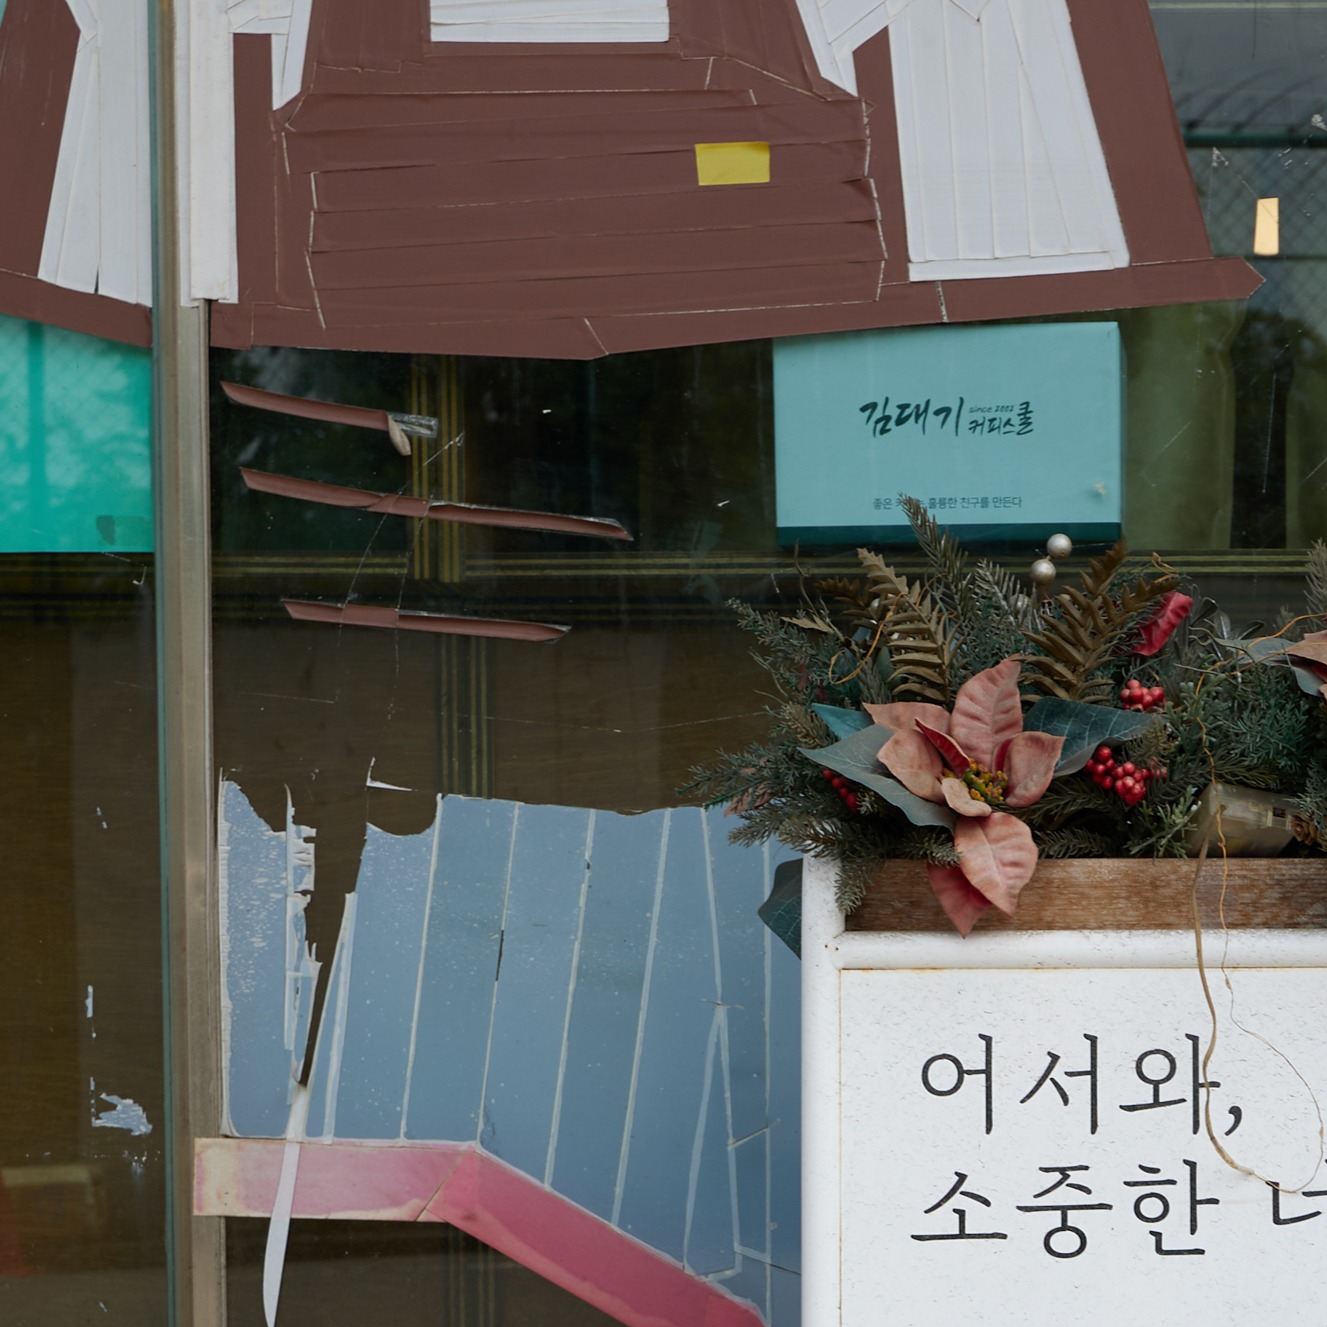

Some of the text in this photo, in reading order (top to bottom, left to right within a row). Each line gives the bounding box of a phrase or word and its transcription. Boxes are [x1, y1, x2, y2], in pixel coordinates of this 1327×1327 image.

[859, 396, 1034, 438] 김대기 커피스쿨
[992, 496, 1022, 508] 만든다
[921, 1033, 1243, 1136] 어서와,
[910, 1158, 1221, 1260] 소중한
